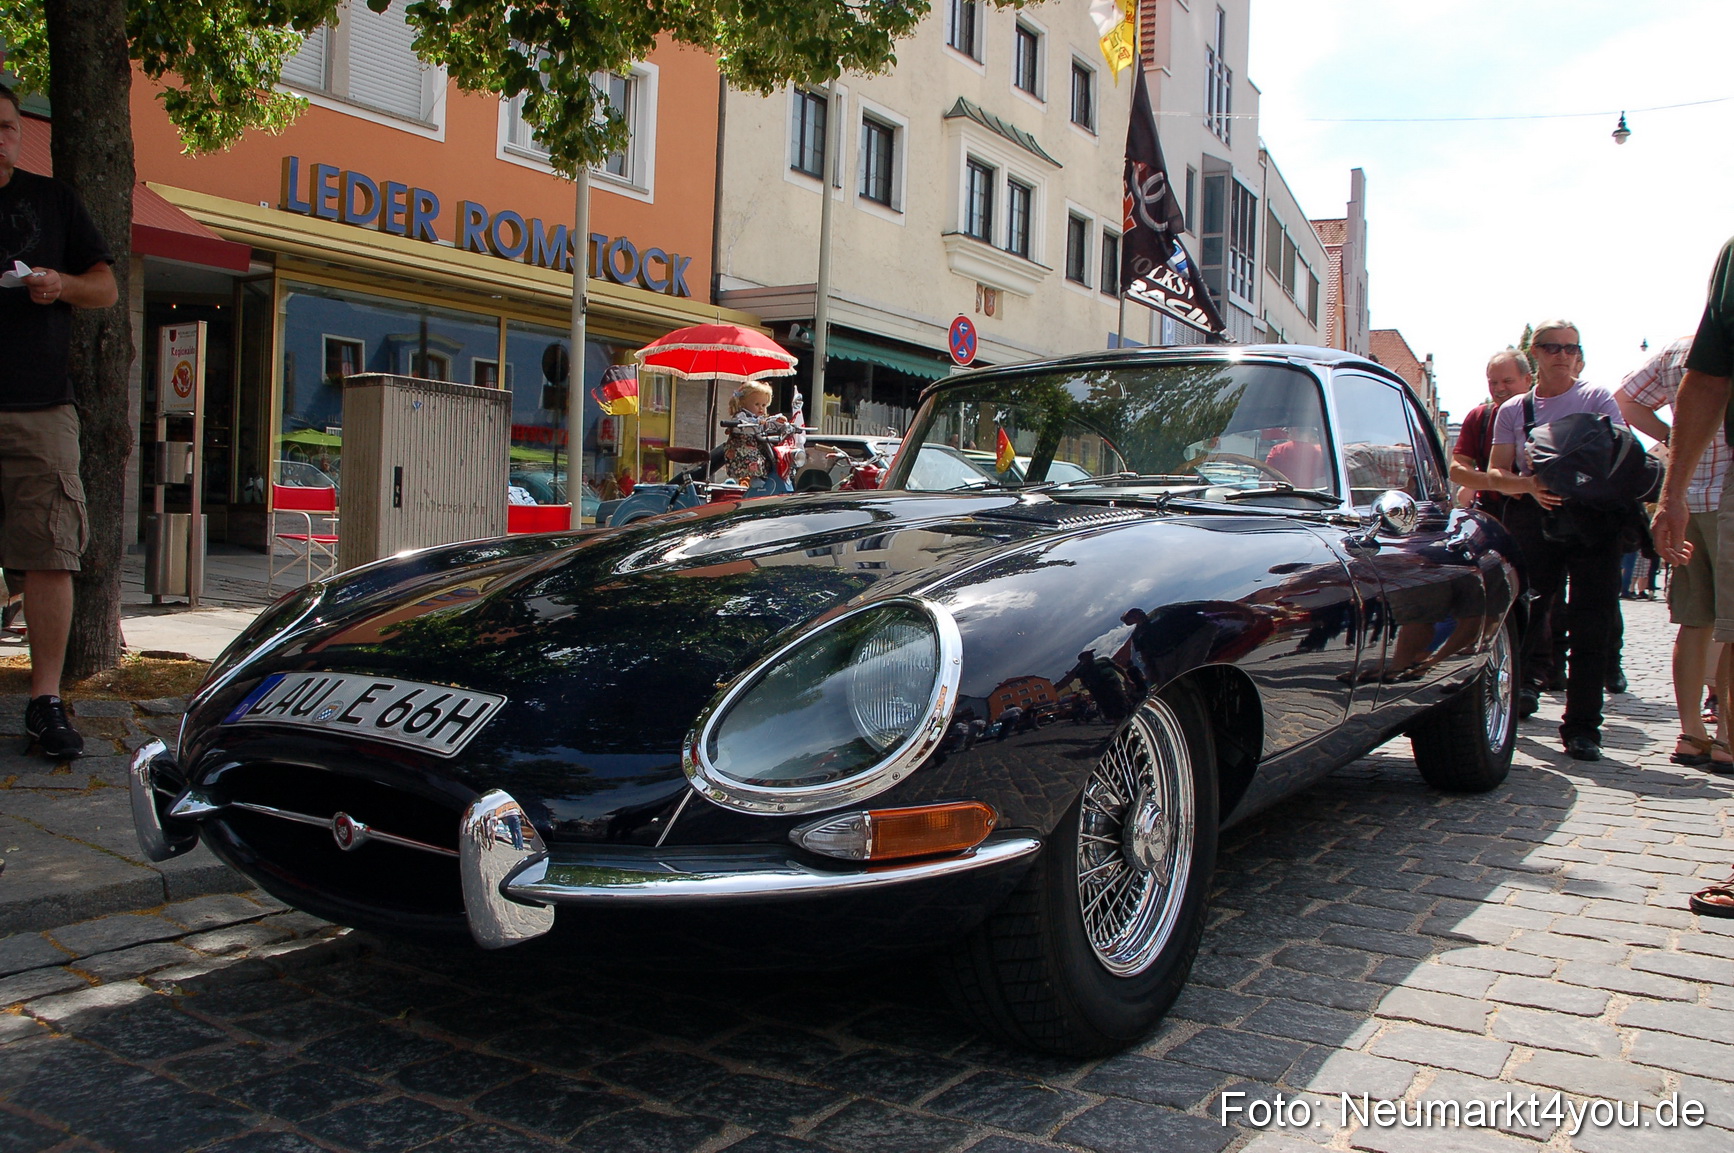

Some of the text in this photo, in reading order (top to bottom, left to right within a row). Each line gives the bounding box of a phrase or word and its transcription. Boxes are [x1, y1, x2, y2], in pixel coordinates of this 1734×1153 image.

[280, 155, 441, 242] LEDER
[247, 677, 494, 744] LAU E 66H
